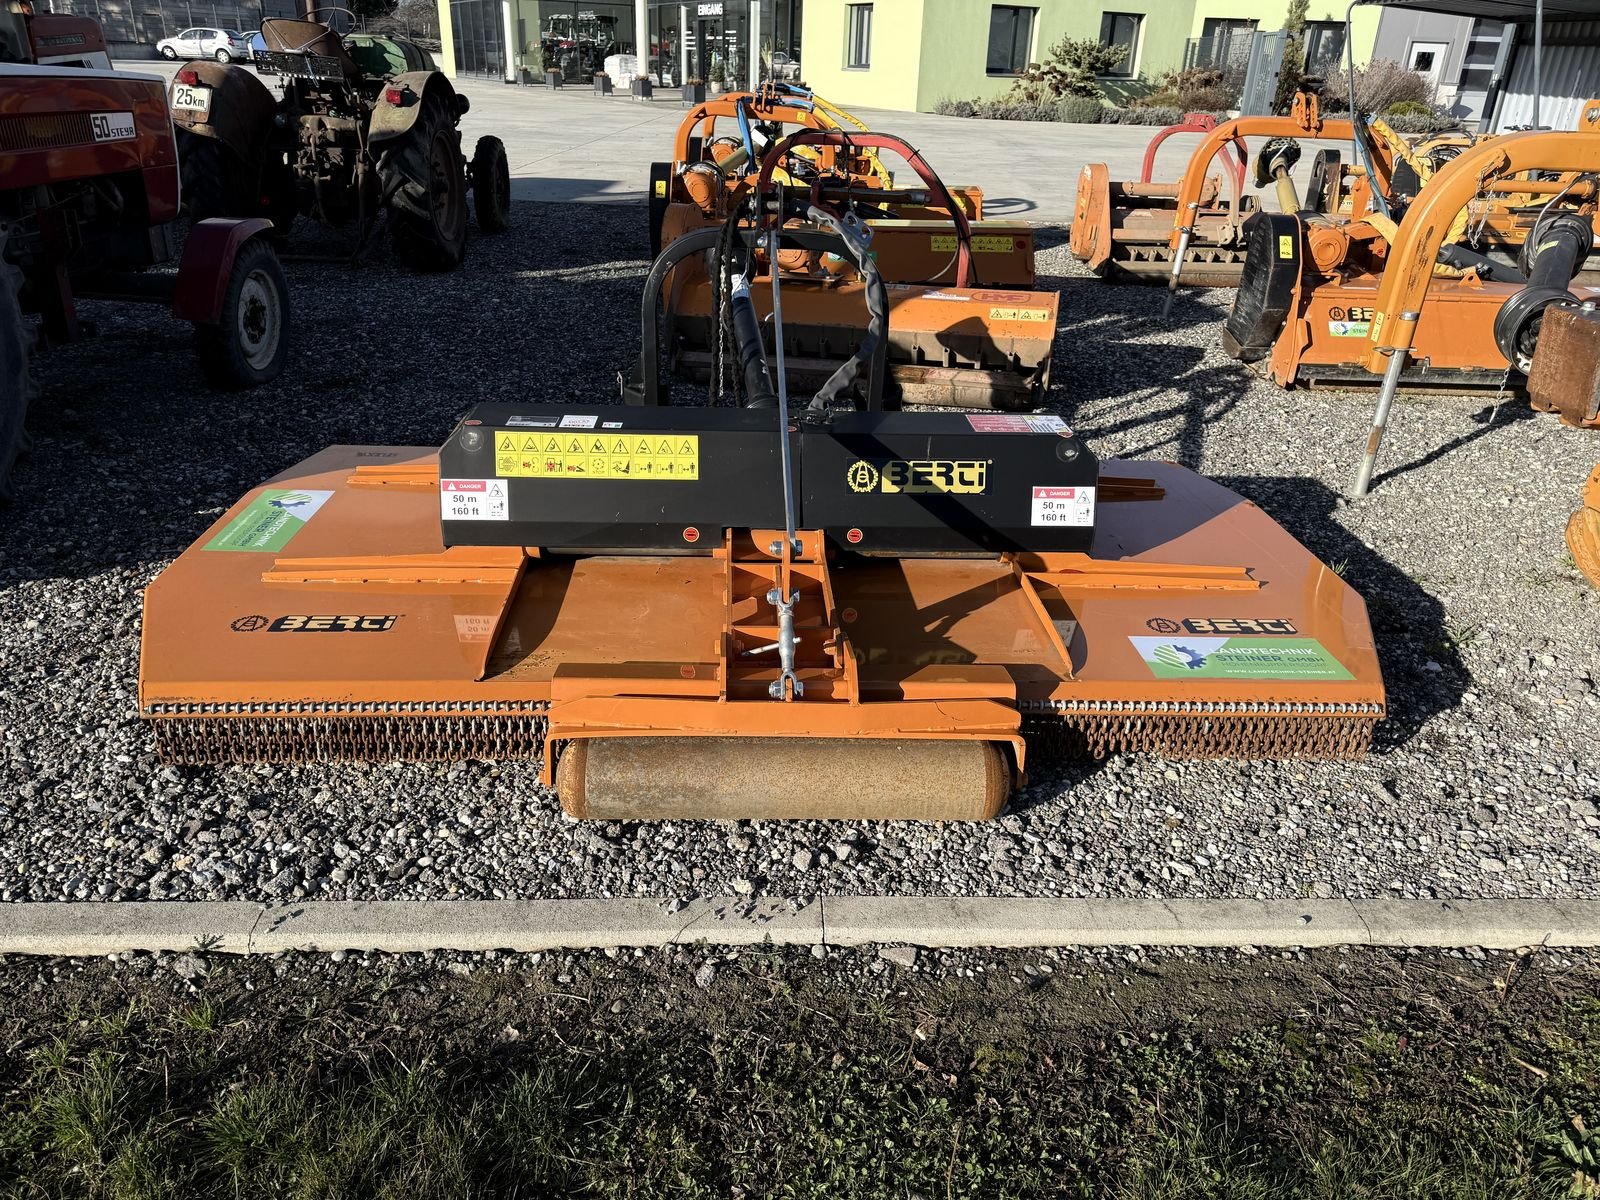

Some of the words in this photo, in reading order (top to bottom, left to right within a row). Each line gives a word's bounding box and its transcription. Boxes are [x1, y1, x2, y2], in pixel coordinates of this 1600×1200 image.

[698, 3, 723, 15] EINGANG
[176, 88, 193, 105] 25
[192, 96, 205, 107] km
[92, 116, 111, 139] 50
[111, 127, 135, 137] STEYR
[452, 494, 464, 503] 50
[1042, 501, 1053, 509] 50
[451, 507, 469, 515] 160
[472, 507, 479, 515] ft
[1041, 513, 1057, 521] 160
[1060, 513, 1066, 521] ft
[1209, 647, 1317, 656] LANDTECHNIK
[1215, 654, 1283, 662] STEINER
